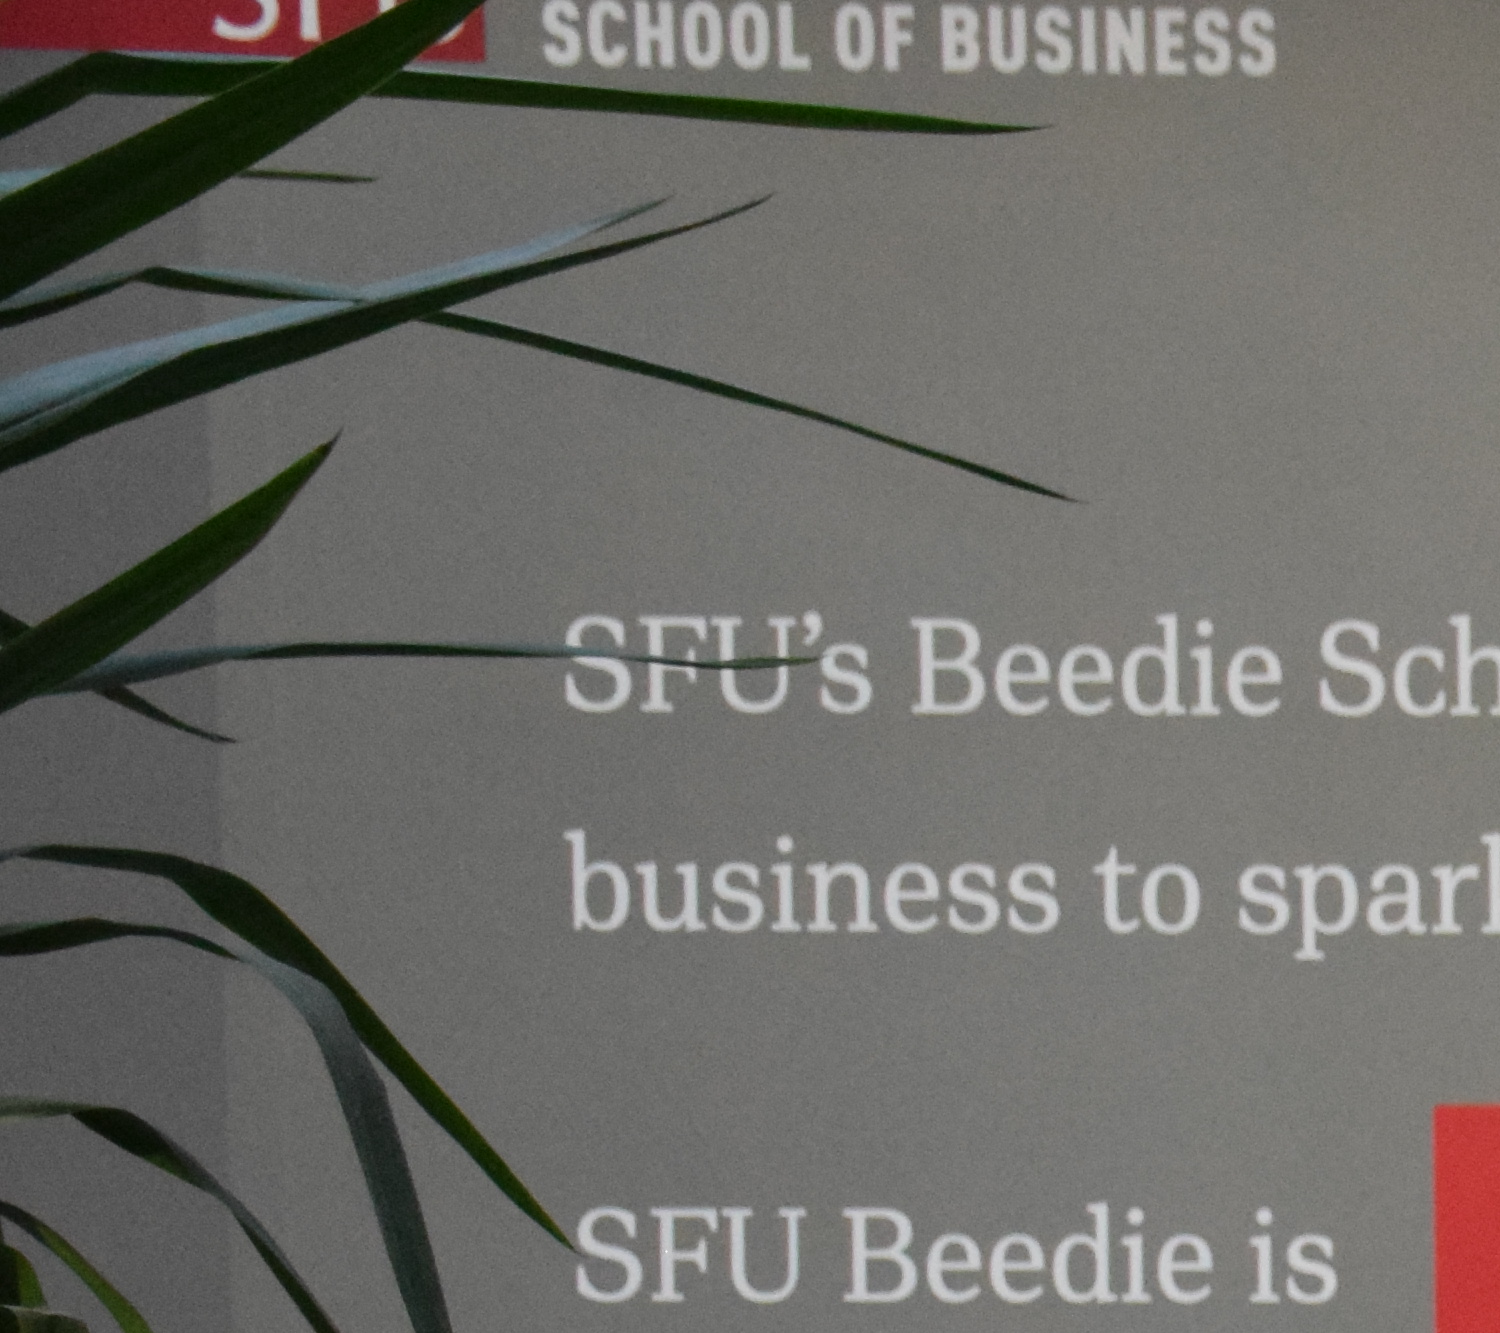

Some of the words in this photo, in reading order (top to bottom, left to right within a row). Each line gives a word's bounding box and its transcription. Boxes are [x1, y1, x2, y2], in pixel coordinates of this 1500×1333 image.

[542, 0, 811, 69] SCHOOL
[834, 3, 914, 72] OF
[941, 5, 1277, 77] BUSINESS
[564, 609, 873, 714] SFU’s
[911, 613, 1283, 717] Beedie
[563, 828, 1062, 934] business
[1093, 846, 1201, 935] to
[575, 1206, 807, 1303] SFU
[843, 1201, 1214, 1304] Beedie
[1249, 1207, 1338, 1304] is
